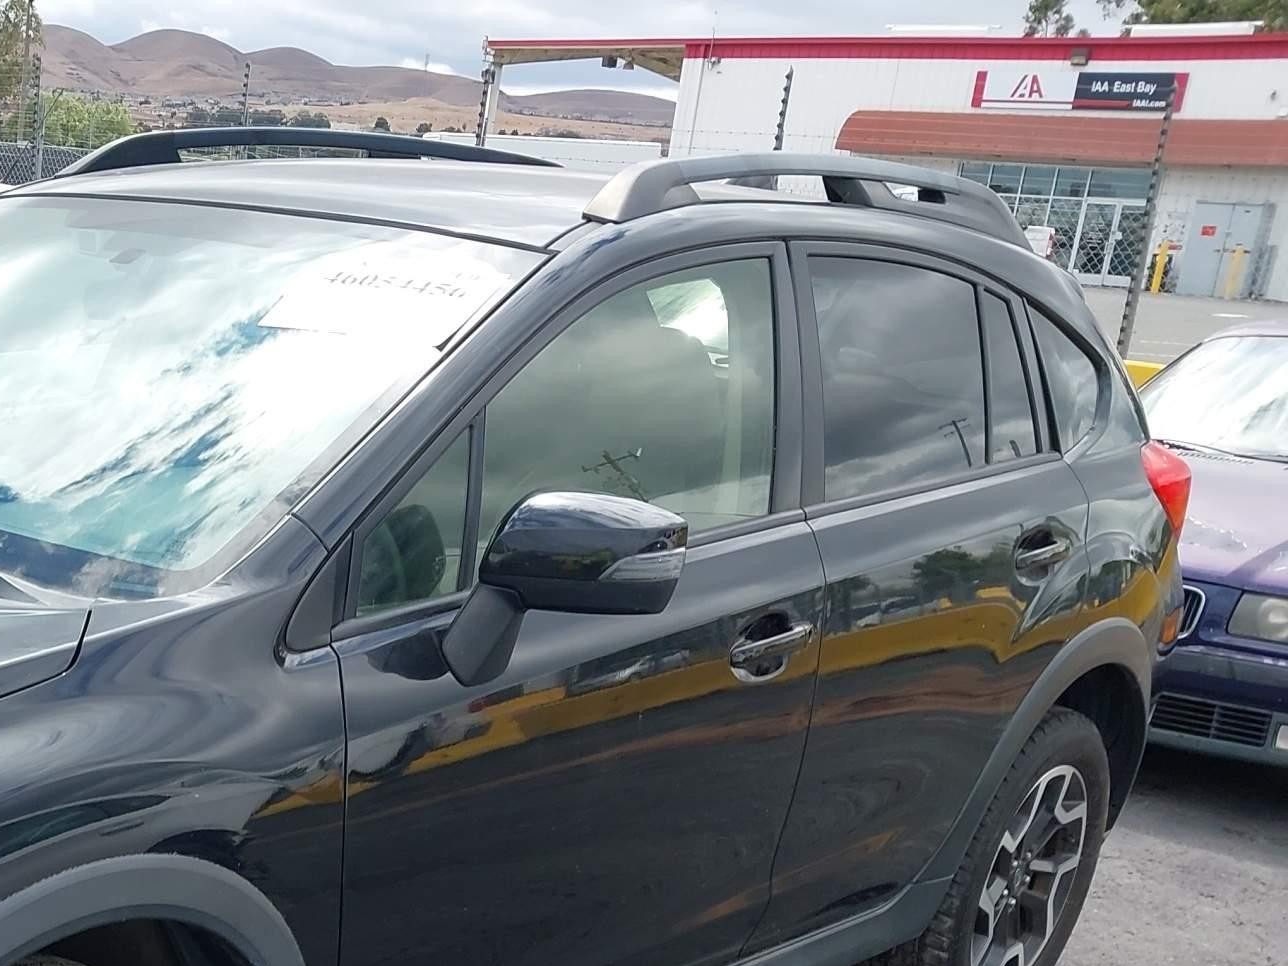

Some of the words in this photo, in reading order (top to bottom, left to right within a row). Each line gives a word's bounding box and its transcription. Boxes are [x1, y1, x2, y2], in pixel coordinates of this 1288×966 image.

[1091, 80, 1109, 93] IAA
[1113, 80, 1136, 93] East
[1136, 80, 1157, 95] Bay
